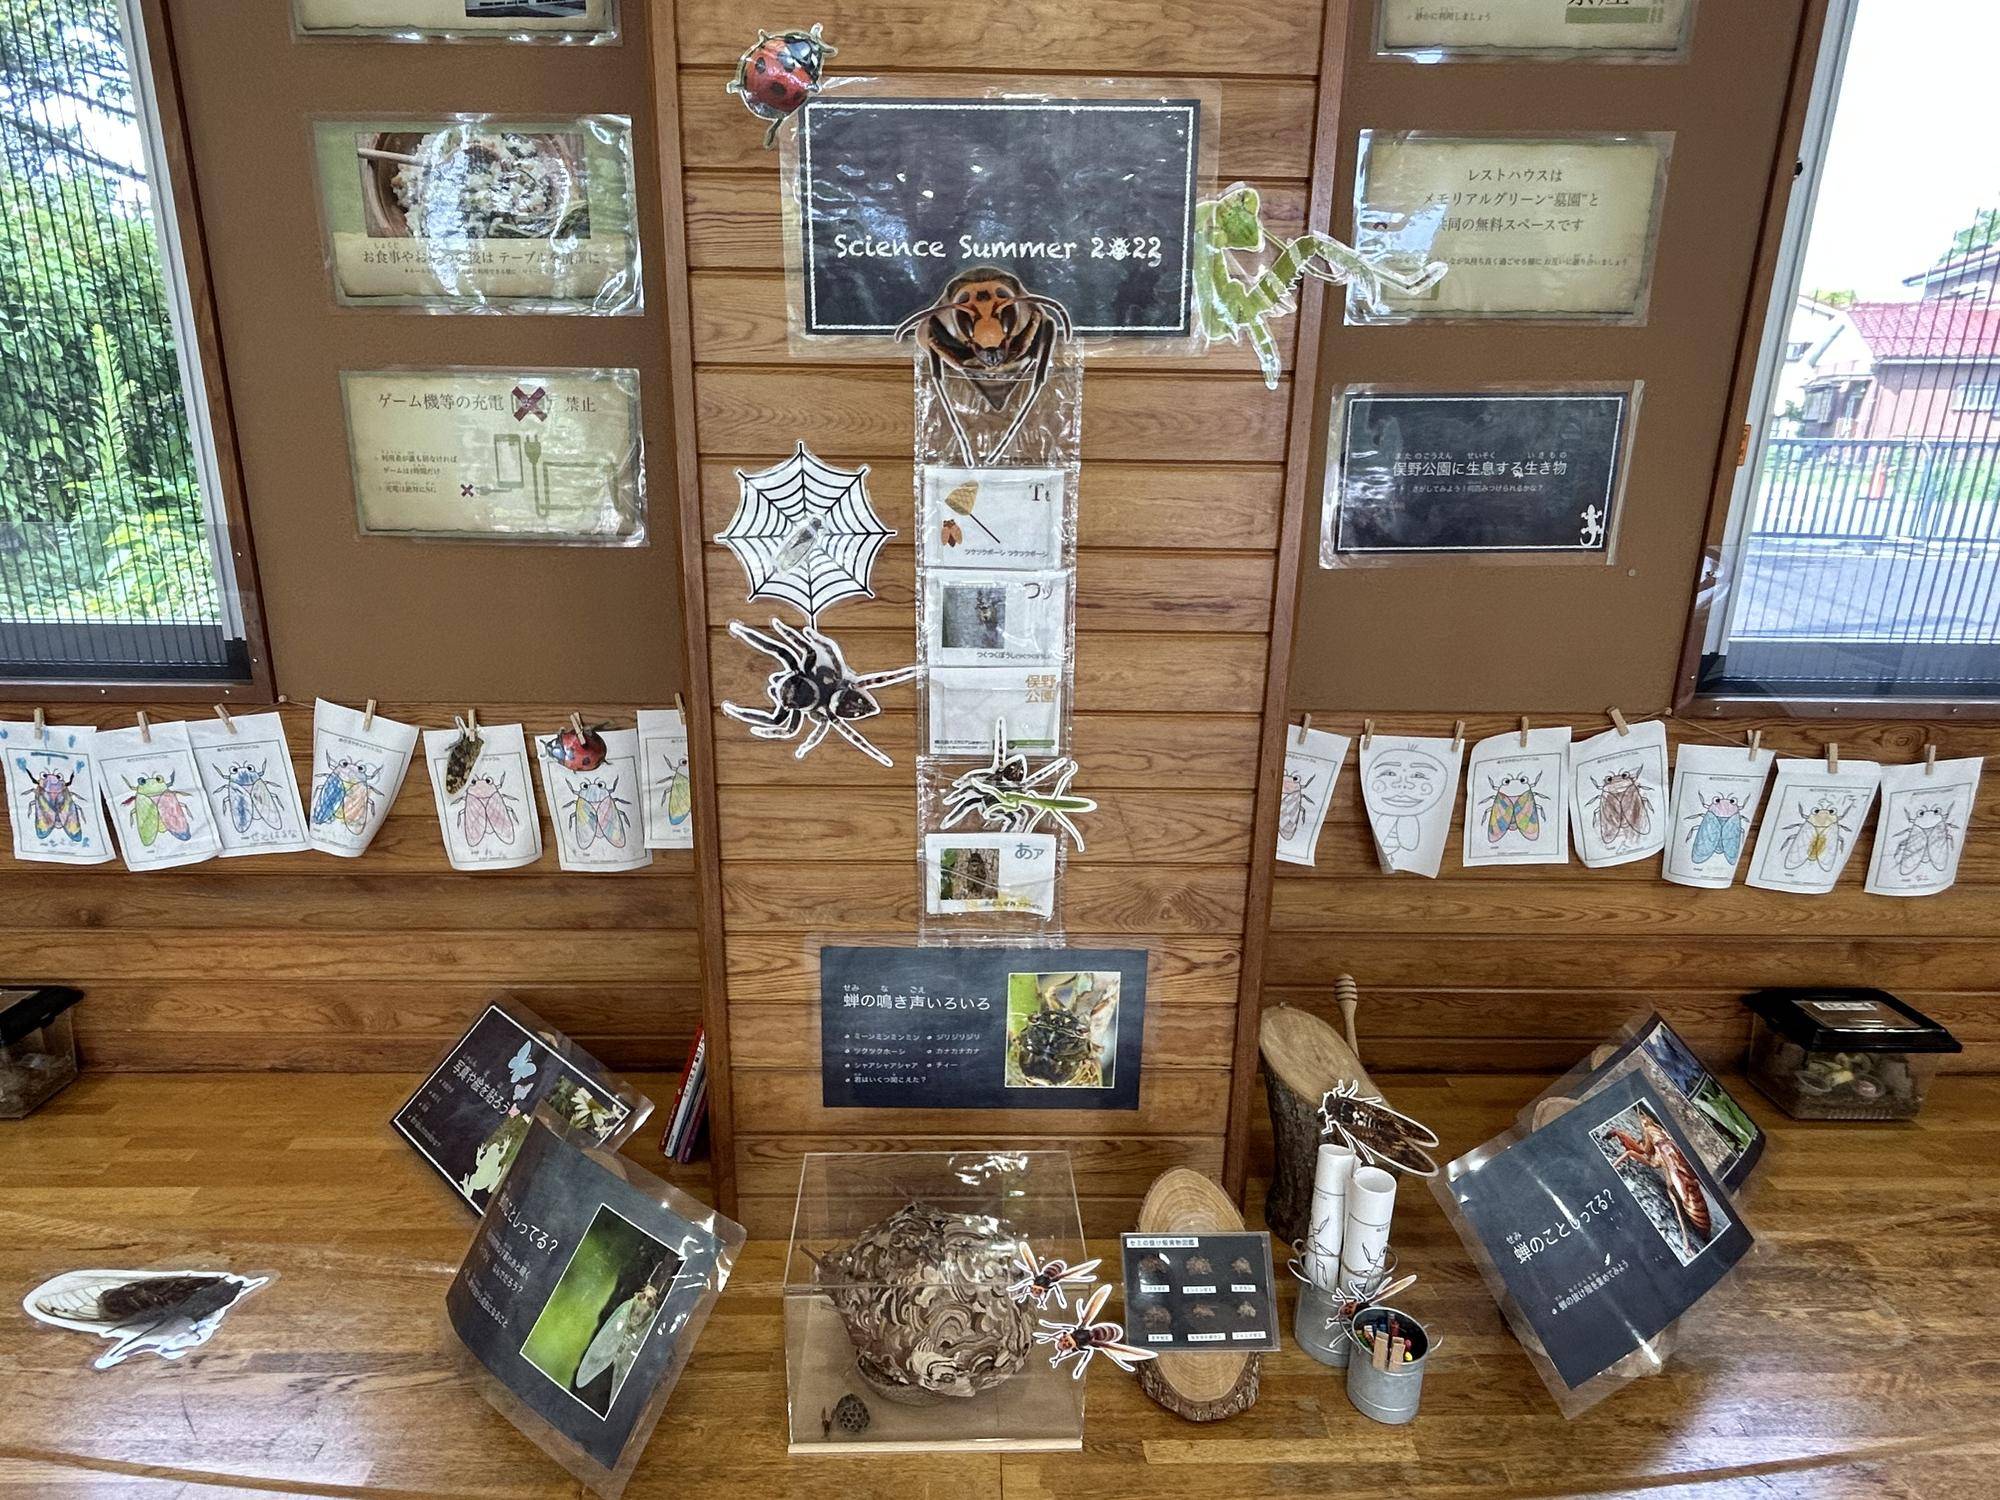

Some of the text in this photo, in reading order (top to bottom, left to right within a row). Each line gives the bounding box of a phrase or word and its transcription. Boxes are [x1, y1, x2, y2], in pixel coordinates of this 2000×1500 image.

[1469, 168, 1563, 182] レストハウスは
[834, 233, 946, 259] Science
[960, 234, 1077, 260] Summer
[378, 393, 597, 412] ゲーム機等の充電 禁止
[1393, 461, 1568, 478] 俣野公園に生息する生き物
[1025, 674, 1057, 688] 俣野
[843, 984, 926, 994] せみ な こえ
[843, 993, 991, 1011] 蝉の鳴き声いろいろ
[854, 1032, 921, 1041] ミーンミンミンミン
[935, 1047, 981, 1055] カナカナカナ
[854, 1061, 919, 1069] シャアシャアシャア
[452, 1059, 512, 1115] 写真や絵を貼ろう
[1512, 1188, 1616, 1265] 蝉のことしってる?
[1505, 1230, 1523, 1246] せみ
